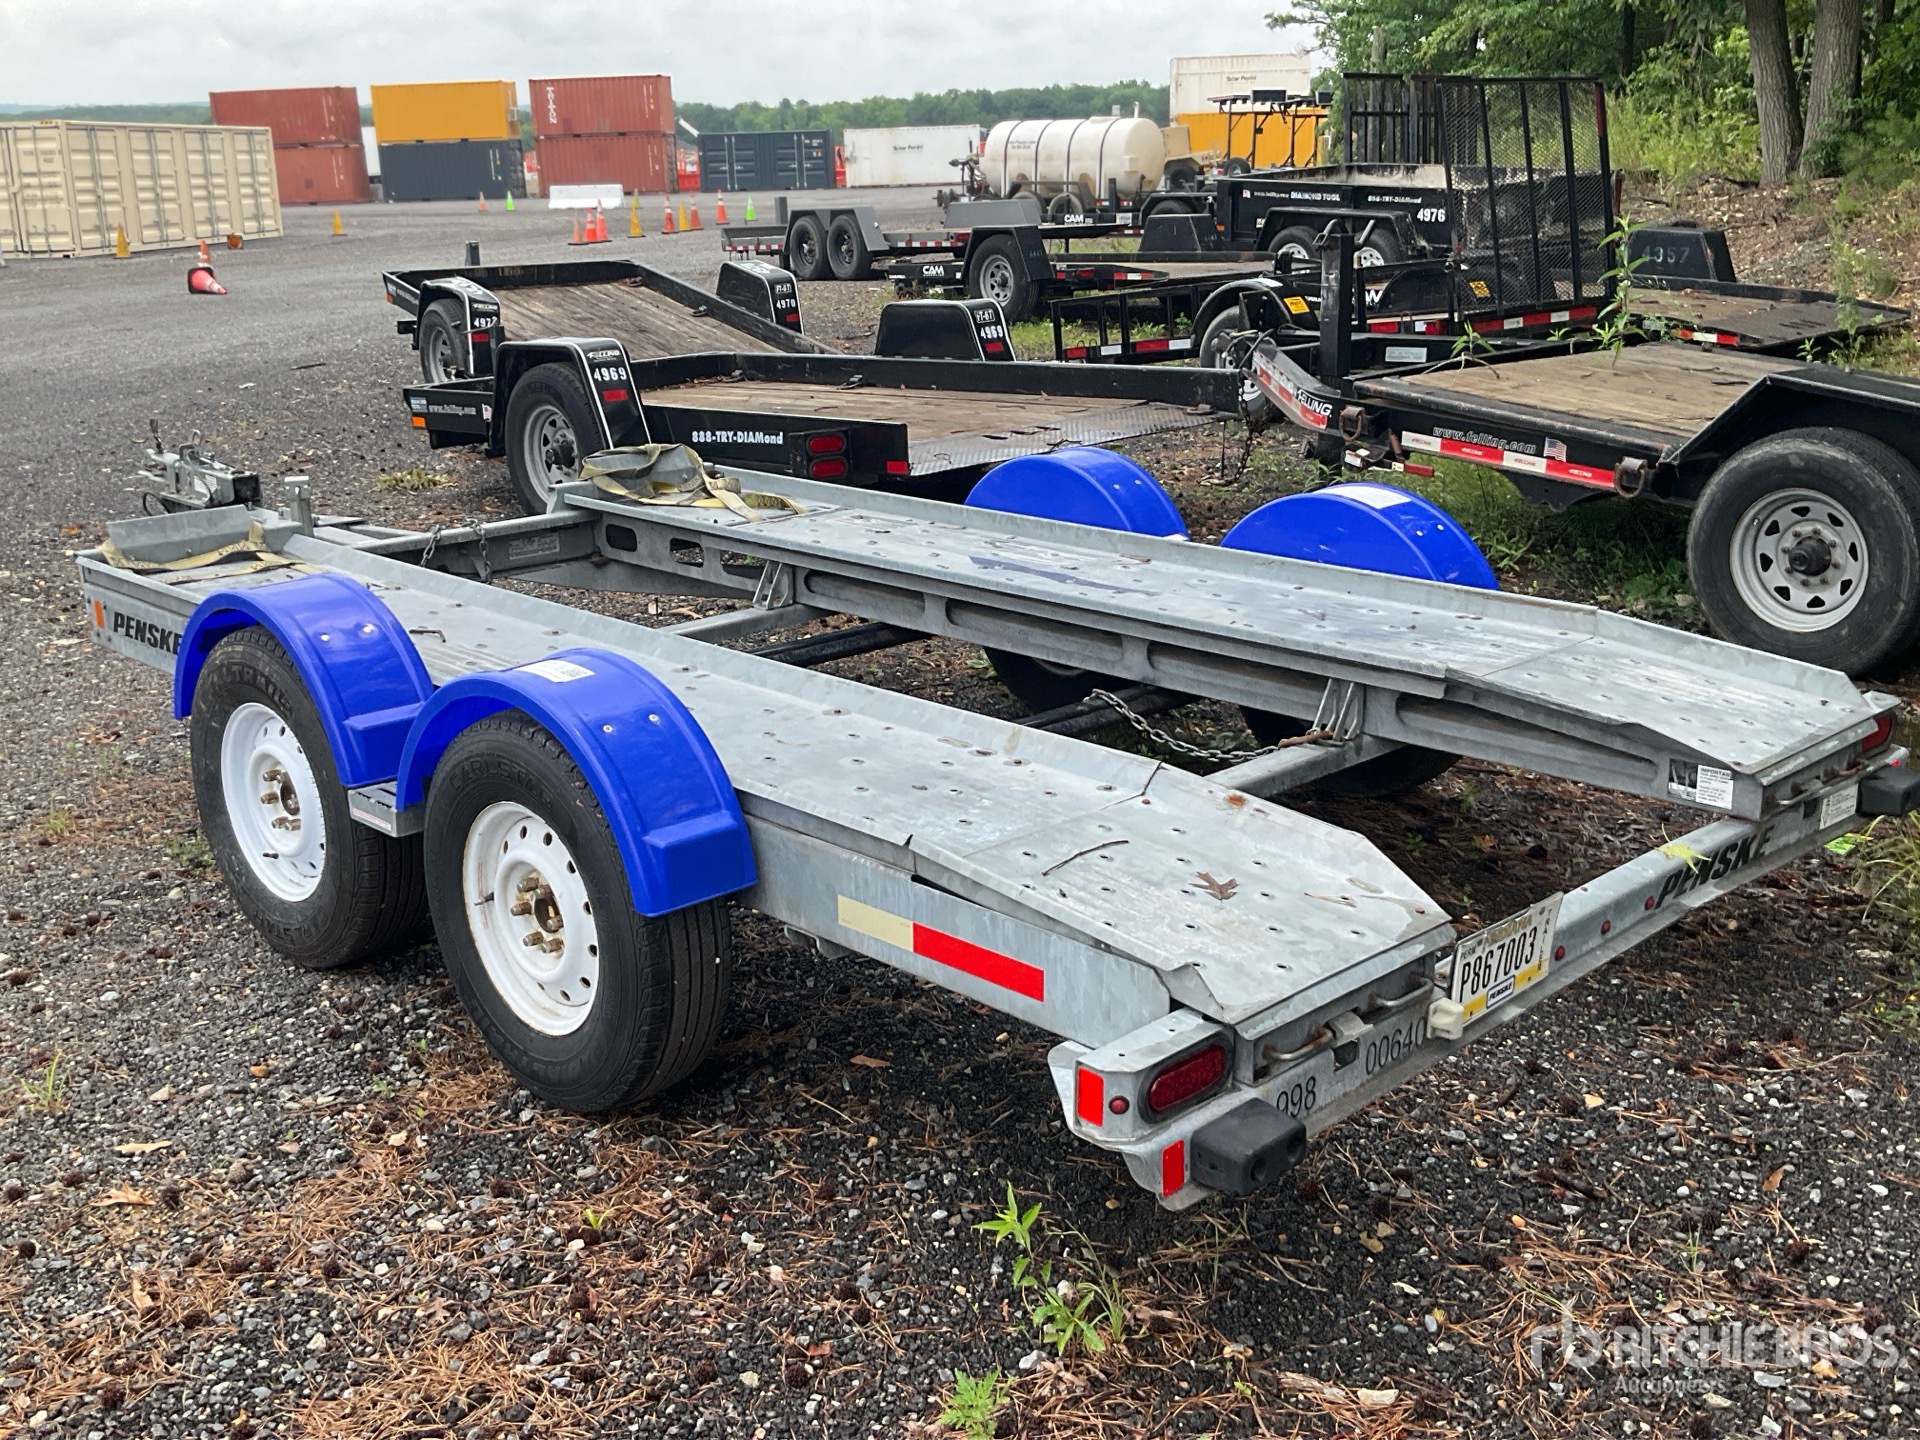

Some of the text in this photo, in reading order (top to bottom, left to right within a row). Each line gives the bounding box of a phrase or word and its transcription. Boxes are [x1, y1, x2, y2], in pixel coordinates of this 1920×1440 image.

[546, 86, 557, 124] TRITON
[1323, 193, 1341, 202] TOOL
[1064, 214, 1084, 223] CAM
[1417, 208, 1446, 223] 4976
[922, 265, 944, 276] CAM
[776, 299, 796, 310] 4970
[980, 325, 1003, 340] 4969
[594, 367, 627, 382] 4969
[691, 430, 784, 445] 888-TRY-DIAMond
[1433, 426, 1536, 454] www.felling.com
[113, 611, 184, 656] PENSKE
[1700, 767, 1731, 777] IMPORTAN
[1654, 823, 1776, 910] PENSKE
[1459, 926, 1538, 1004] P867003
[1489, 982, 1513, 1000] PENSKE
[1365, 1016, 1427, 1075] 00640
